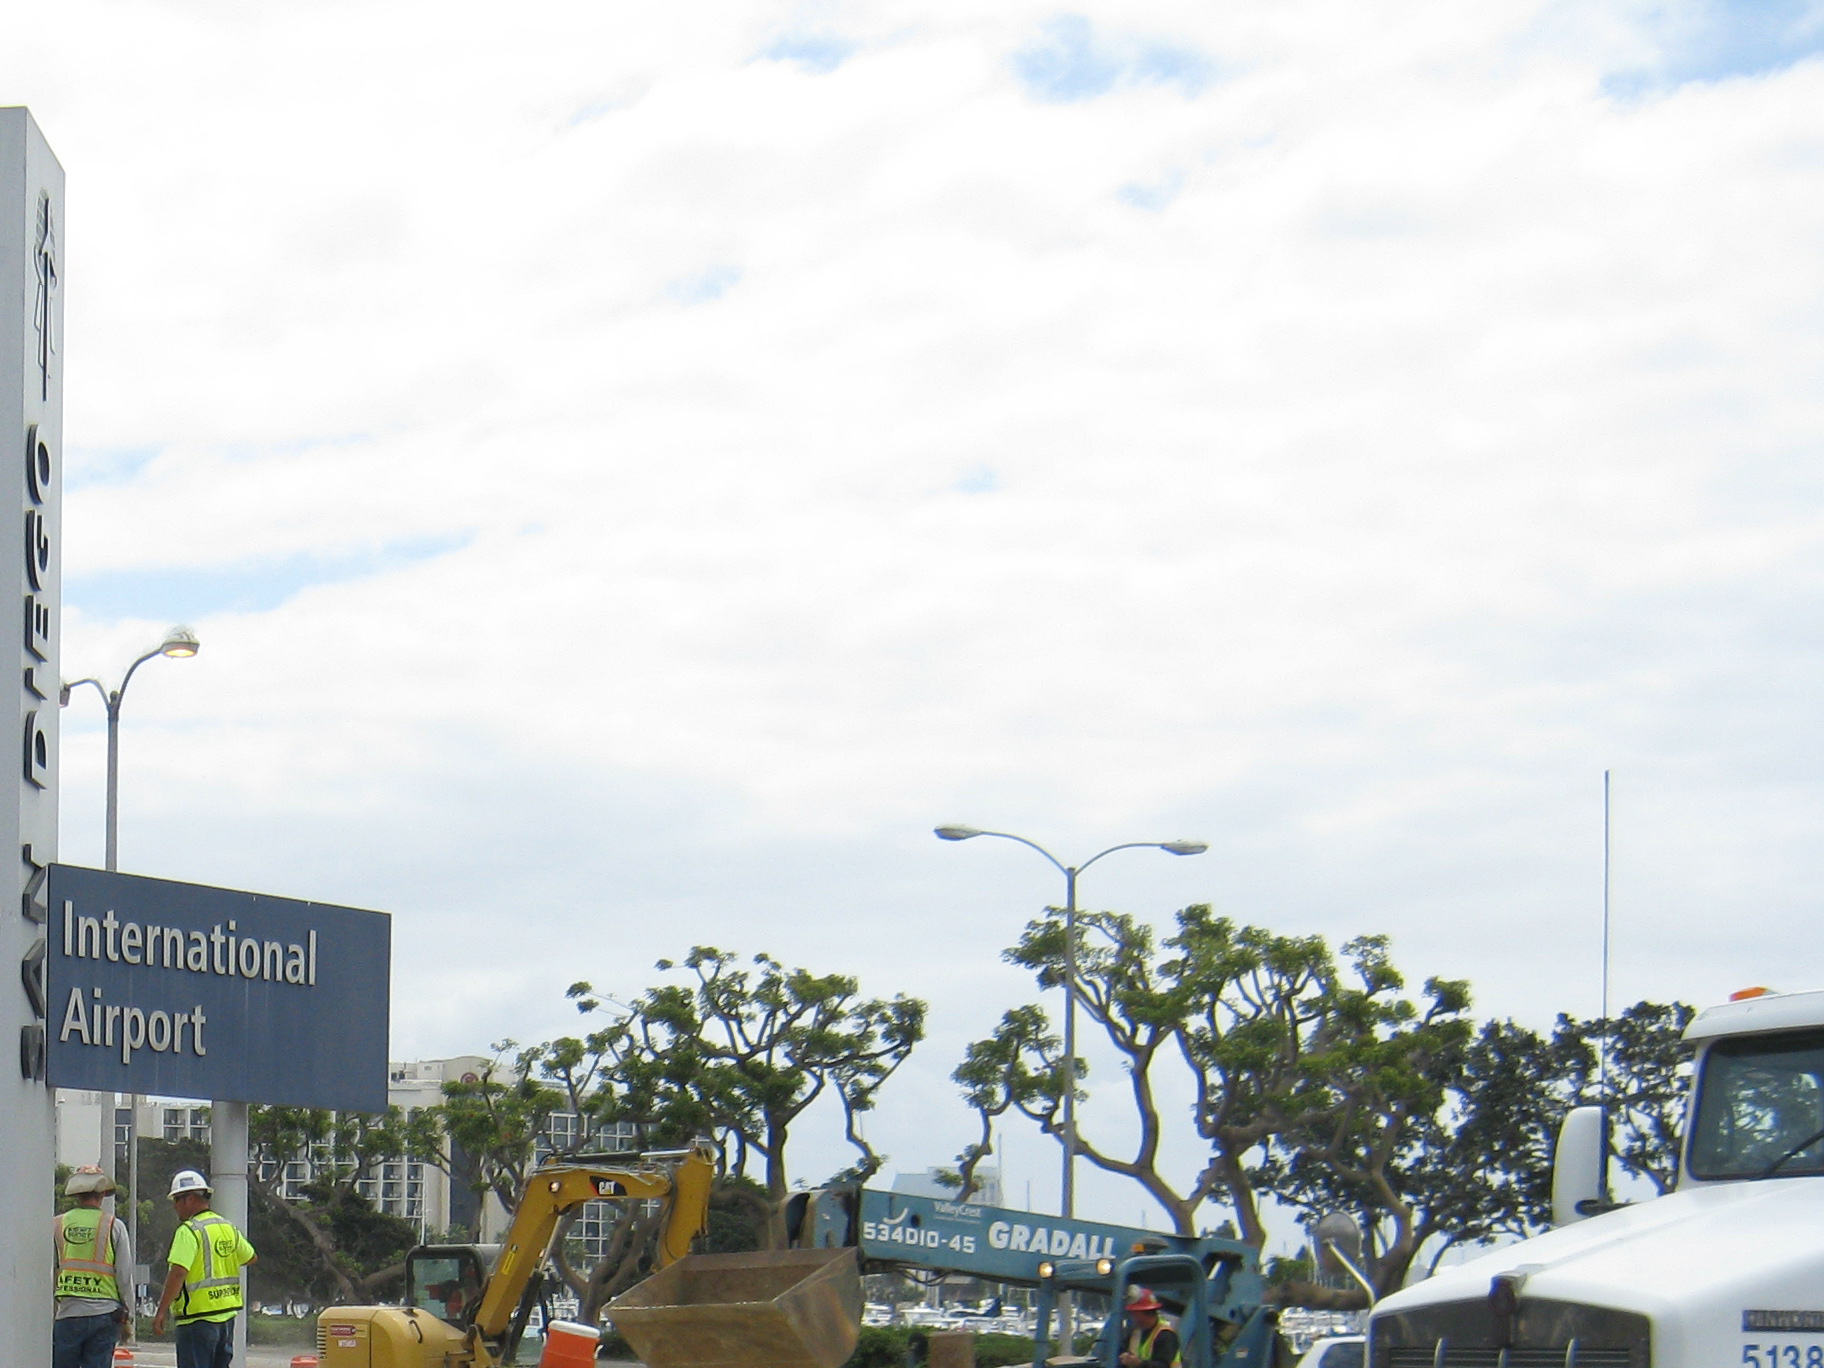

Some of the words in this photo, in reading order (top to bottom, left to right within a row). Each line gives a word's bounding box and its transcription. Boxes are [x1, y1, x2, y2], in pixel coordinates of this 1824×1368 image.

[25, 422, 51, 792] DIEGO
[62, 900, 317, 985] International
[60, 986, 207, 1064] Airport
[598, 1181, 616, 1195] CAT
[988, 1220, 1117, 1260] GRADALL
